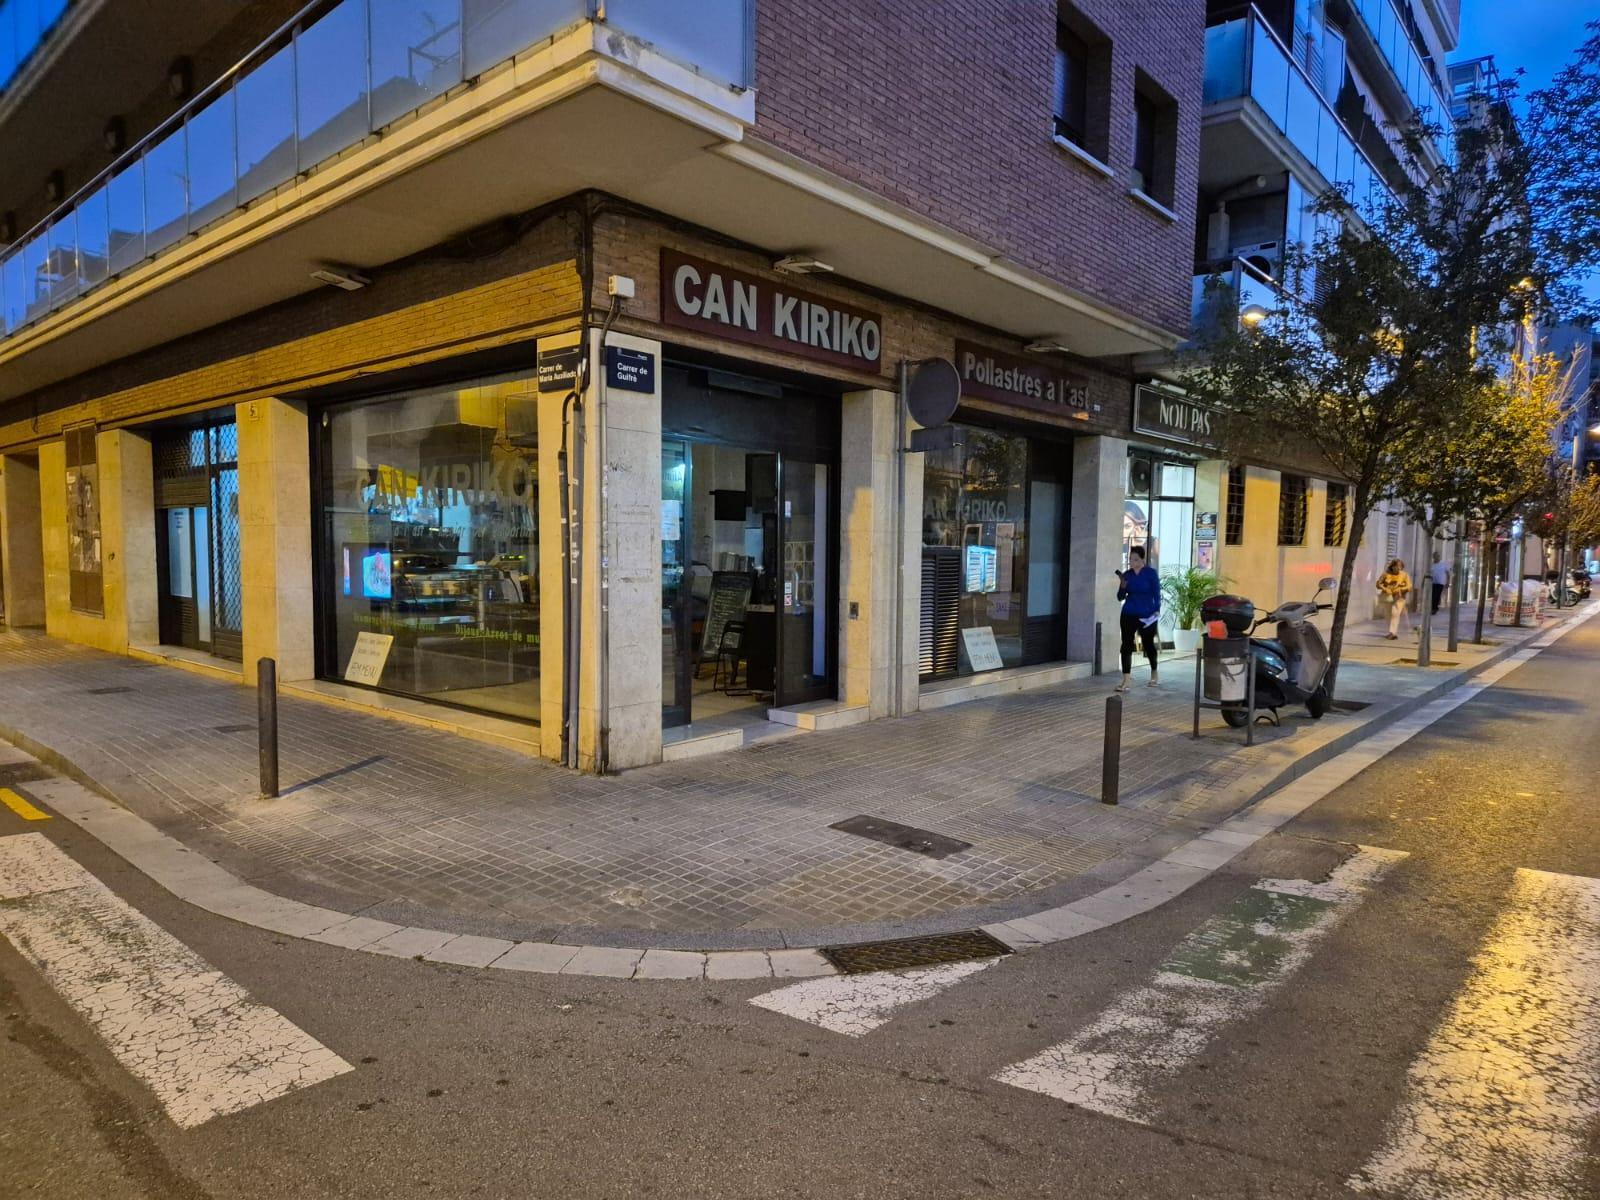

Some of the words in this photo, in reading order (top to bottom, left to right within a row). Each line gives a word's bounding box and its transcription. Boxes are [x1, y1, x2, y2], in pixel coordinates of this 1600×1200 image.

[675, 265, 757, 331] CAN
[774, 292, 881, 361] KIRIKO
[539, 366, 555, 374] Carrer
[555, 363, 563, 371] de
[617, 362, 638, 373] Carrer
[639, 367, 648, 375] de
[964, 352, 1042, 397] Pollastres
[1046, 382, 1055, 401] a
[1159, 399, 1188, 430] NOU
[1190, 408, 1211, 435] PAS
[421, 459, 532, 507] KIRIKO
